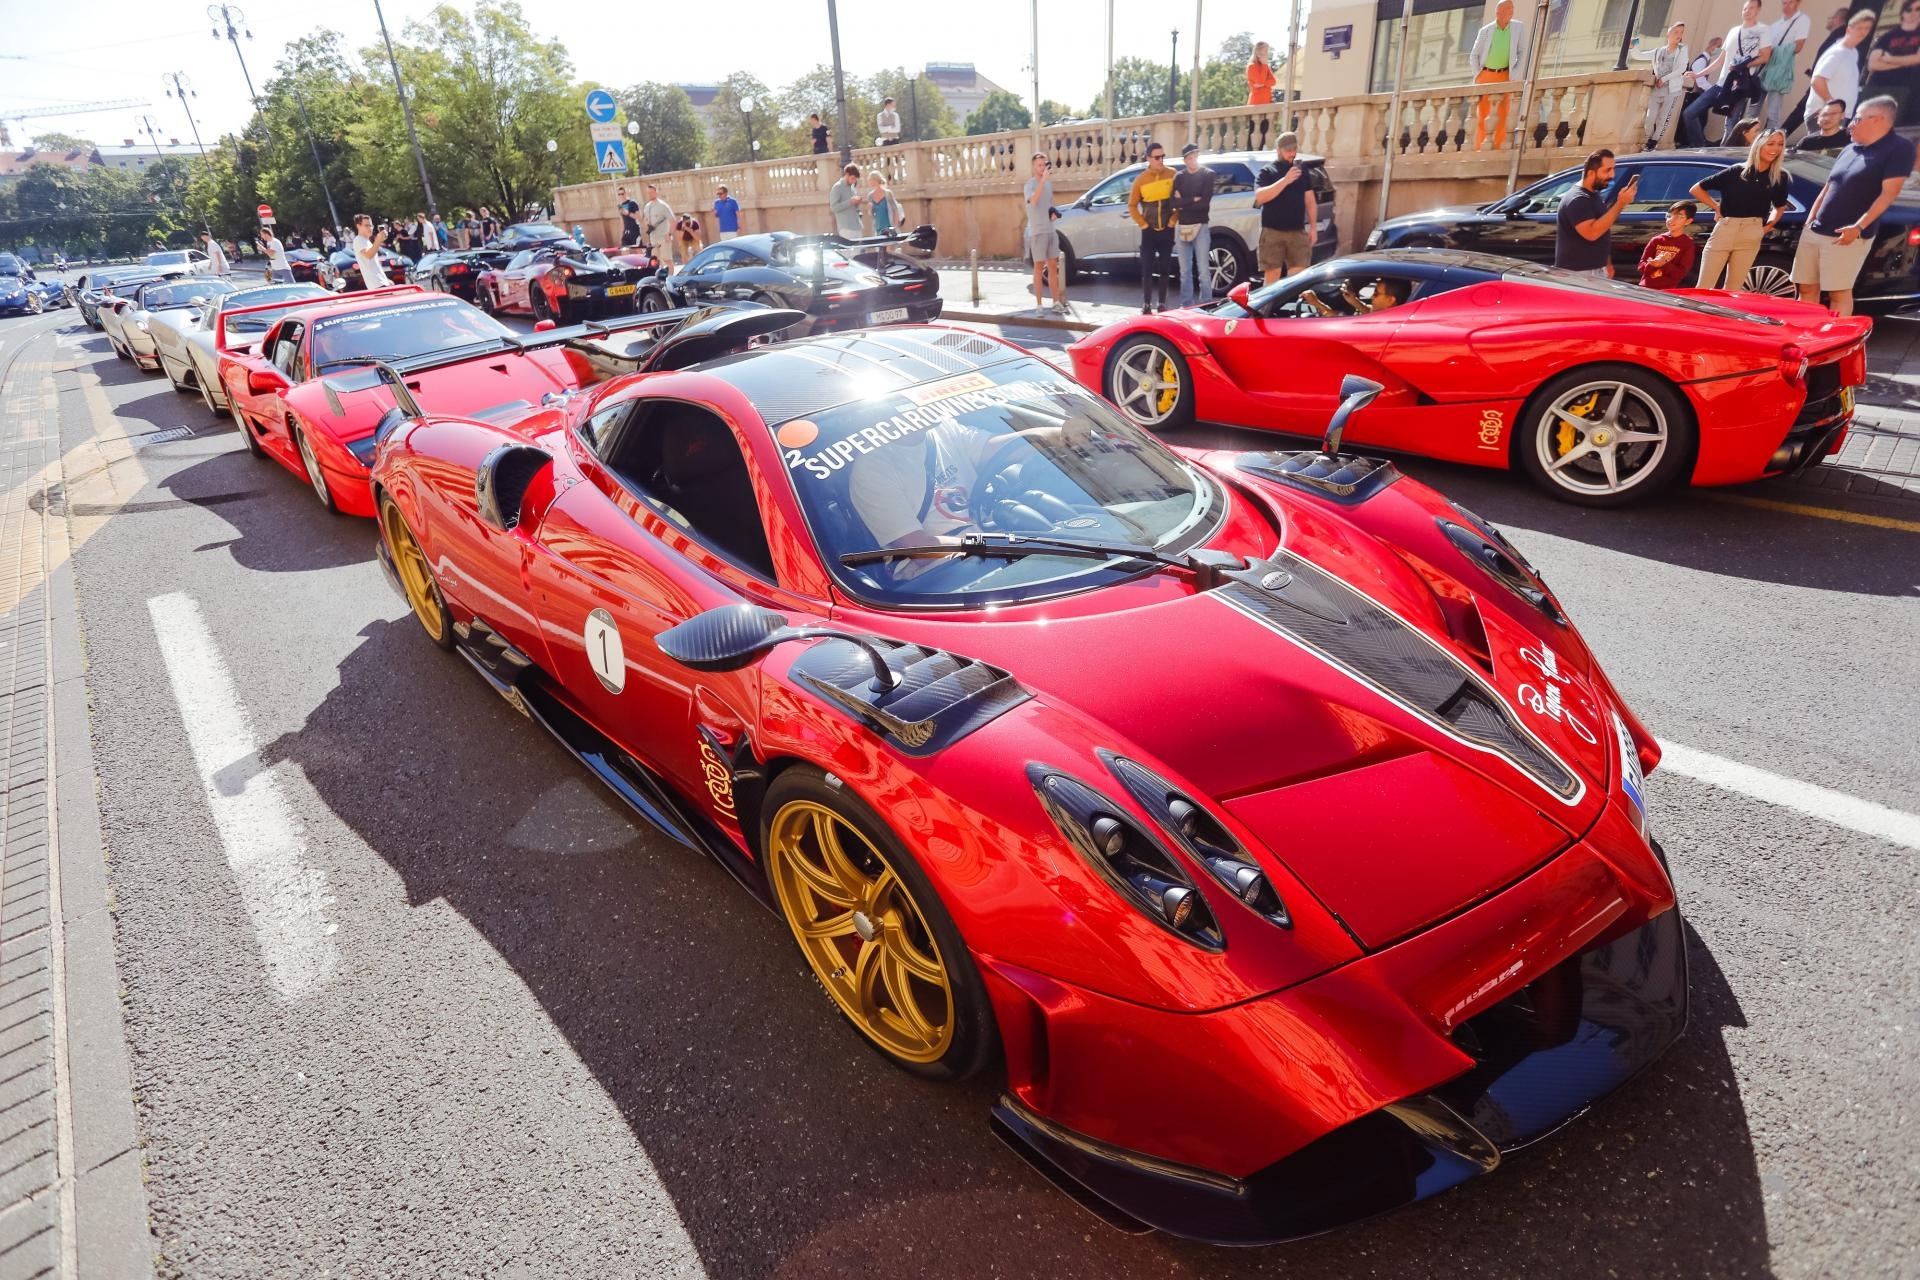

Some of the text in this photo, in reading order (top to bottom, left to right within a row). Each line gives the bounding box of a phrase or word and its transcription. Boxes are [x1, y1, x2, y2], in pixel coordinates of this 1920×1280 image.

[918, 377, 985, 401] PIRELLI
[785, 380, 1096, 480] 2 SUPERCAROWNERSCIRCLE
[598, 629, 609, 674] 1
[1520, 640, 1571, 685] Rad
